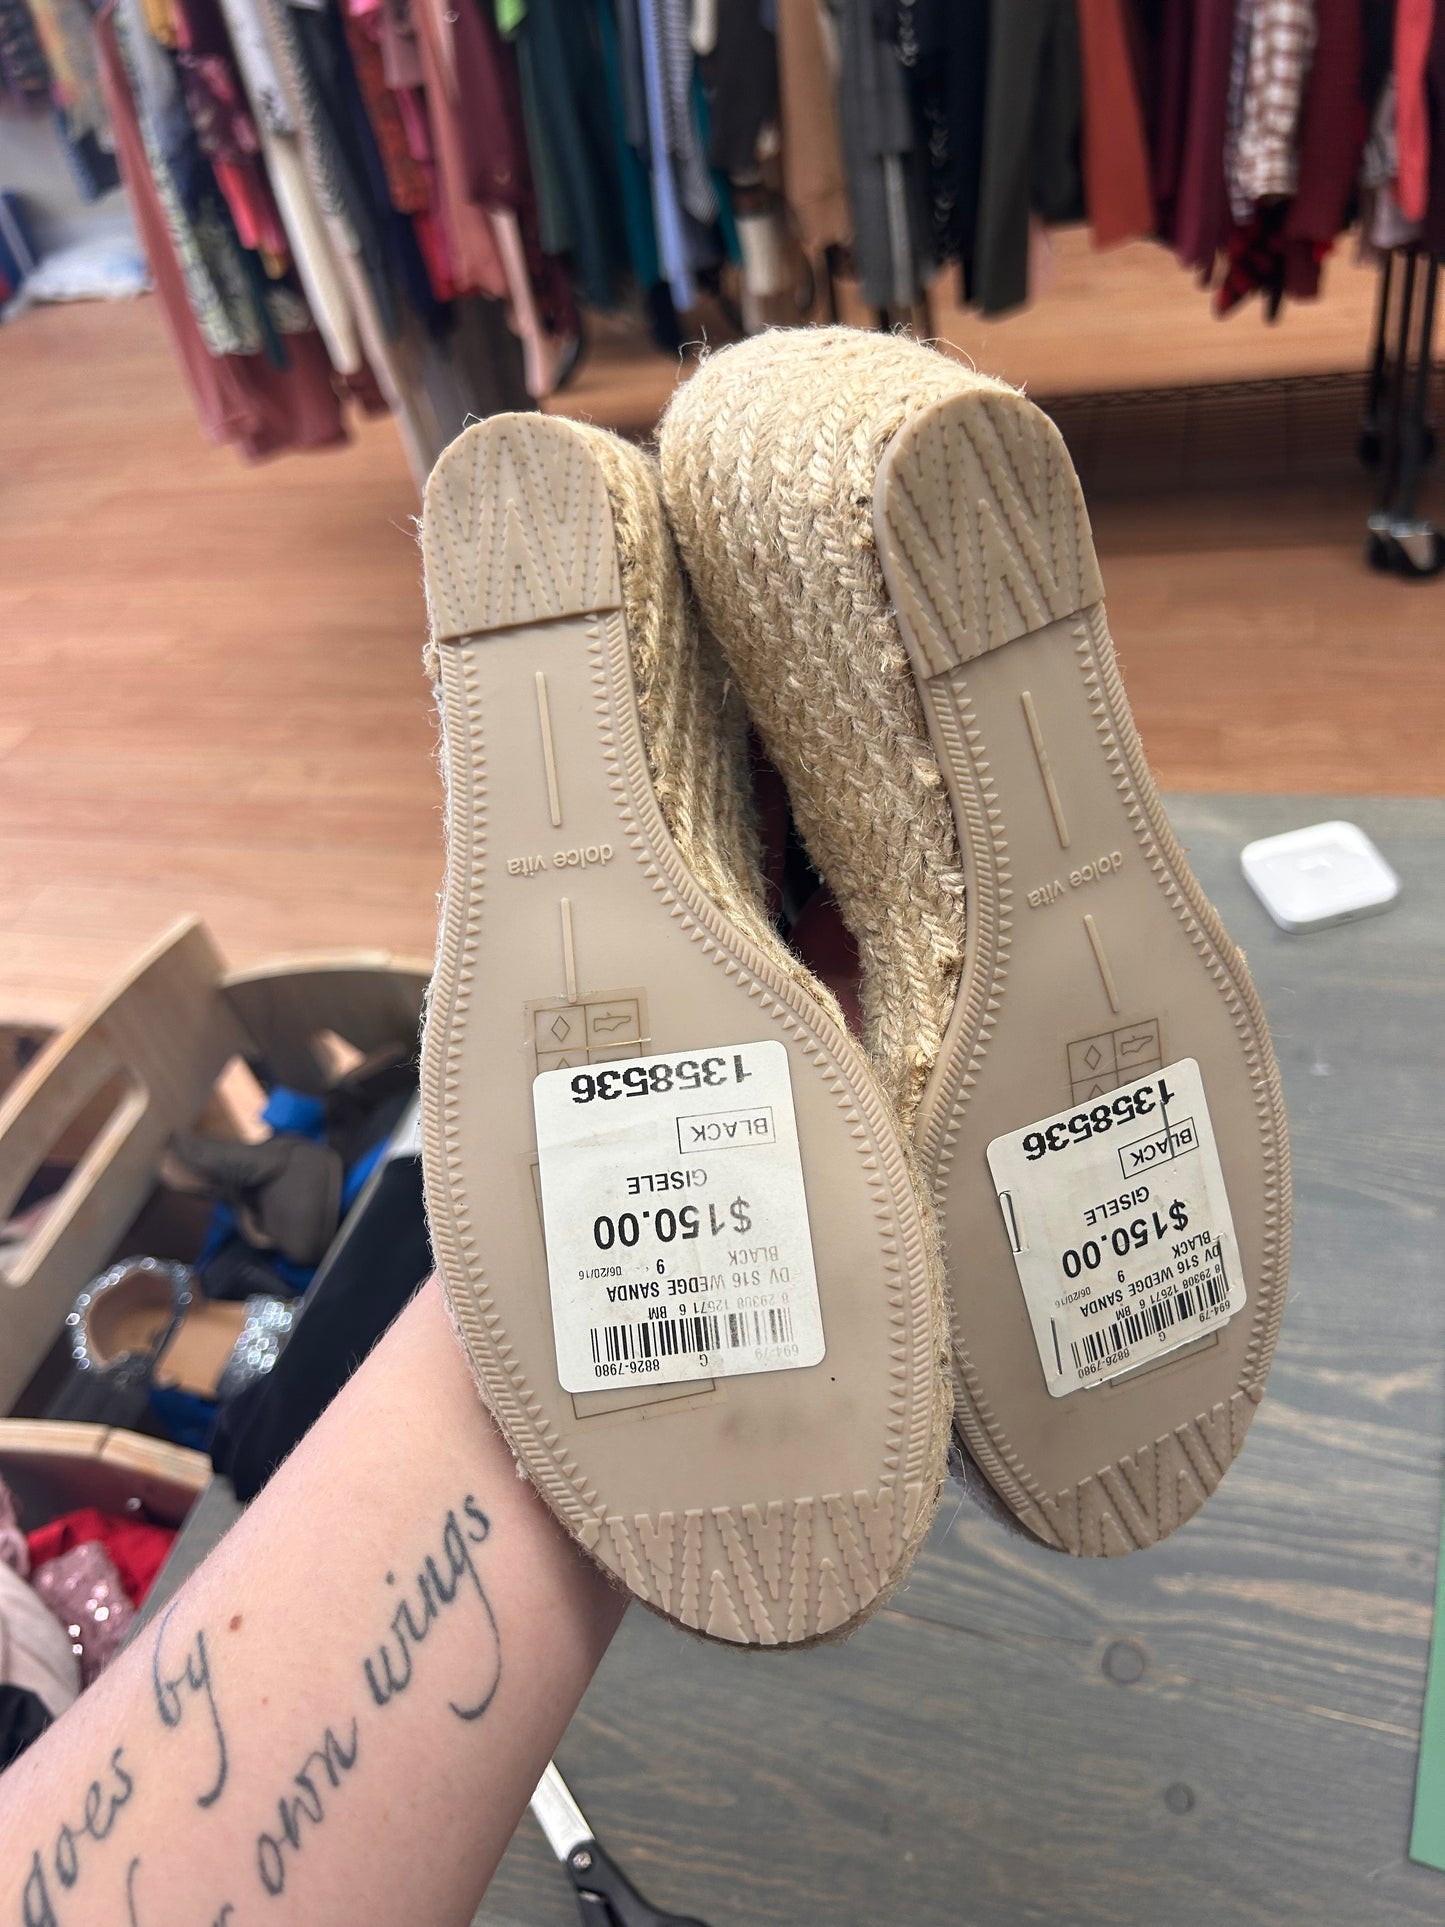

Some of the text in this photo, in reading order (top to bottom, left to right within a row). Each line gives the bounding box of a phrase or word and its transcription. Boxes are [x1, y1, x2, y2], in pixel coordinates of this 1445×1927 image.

[507, 844, 613, 876] dolce vita
[1027, 851, 1122, 907] dolce vita
[571, 1055, 752, 1104] 1358536
[690, 1117, 768, 1142] BLACK
[1022, 1079, 1174, 1161] 1358536
[1129, 1127, 1192, 1166] BLACK
[626, 1169, 707, 1194] GISELE
[1083, 1186, 1149, 1226] GISELE
[593, 1196, 752, 1250] $150.00
[1061, 1200, 1189, 1278] $150.00
[1171, 1230, 1210, 1257] BLACK
[656, 1259, 665, 1274] 9
[728, 1246, 778, 1264] BLACK
[1177, 1254, 1199, 1272] S16
[578, 1265, 622, 1280] 06/20/16
[606, 1268, 789, 1302] DV S16 WEDGE SANDA
[1117, 1270, 1124, 1282] 9
[1127, 1266, 1173, 1294] WEDGE
[1182, 1268, 1211, 1289] 29308
[648, 1306, 667, 1319] BM
[679, 1304, 686, 1316] 6
[693, 1299, 728, 1313] 12571
[1079, 1289, 1123, 1316] SANDA
[1115, 1305, 1131, 1320] BM
[1139, 1299, 1145, 1309] 6
[1198, 1300, 1230, 1322] 694-79
[1158, 1332, 1165, 1342] G
[699, 1354, 708, 1367] G
[754, 1344, 798, 1358] 694-79
[1077, 1348, 1129, 1378] 8826-7980
[594, 1359, 660, 1377] 8826-7980
[362, 1493, 502, 1720] wings
[152, 1601, 228, 1808] by
